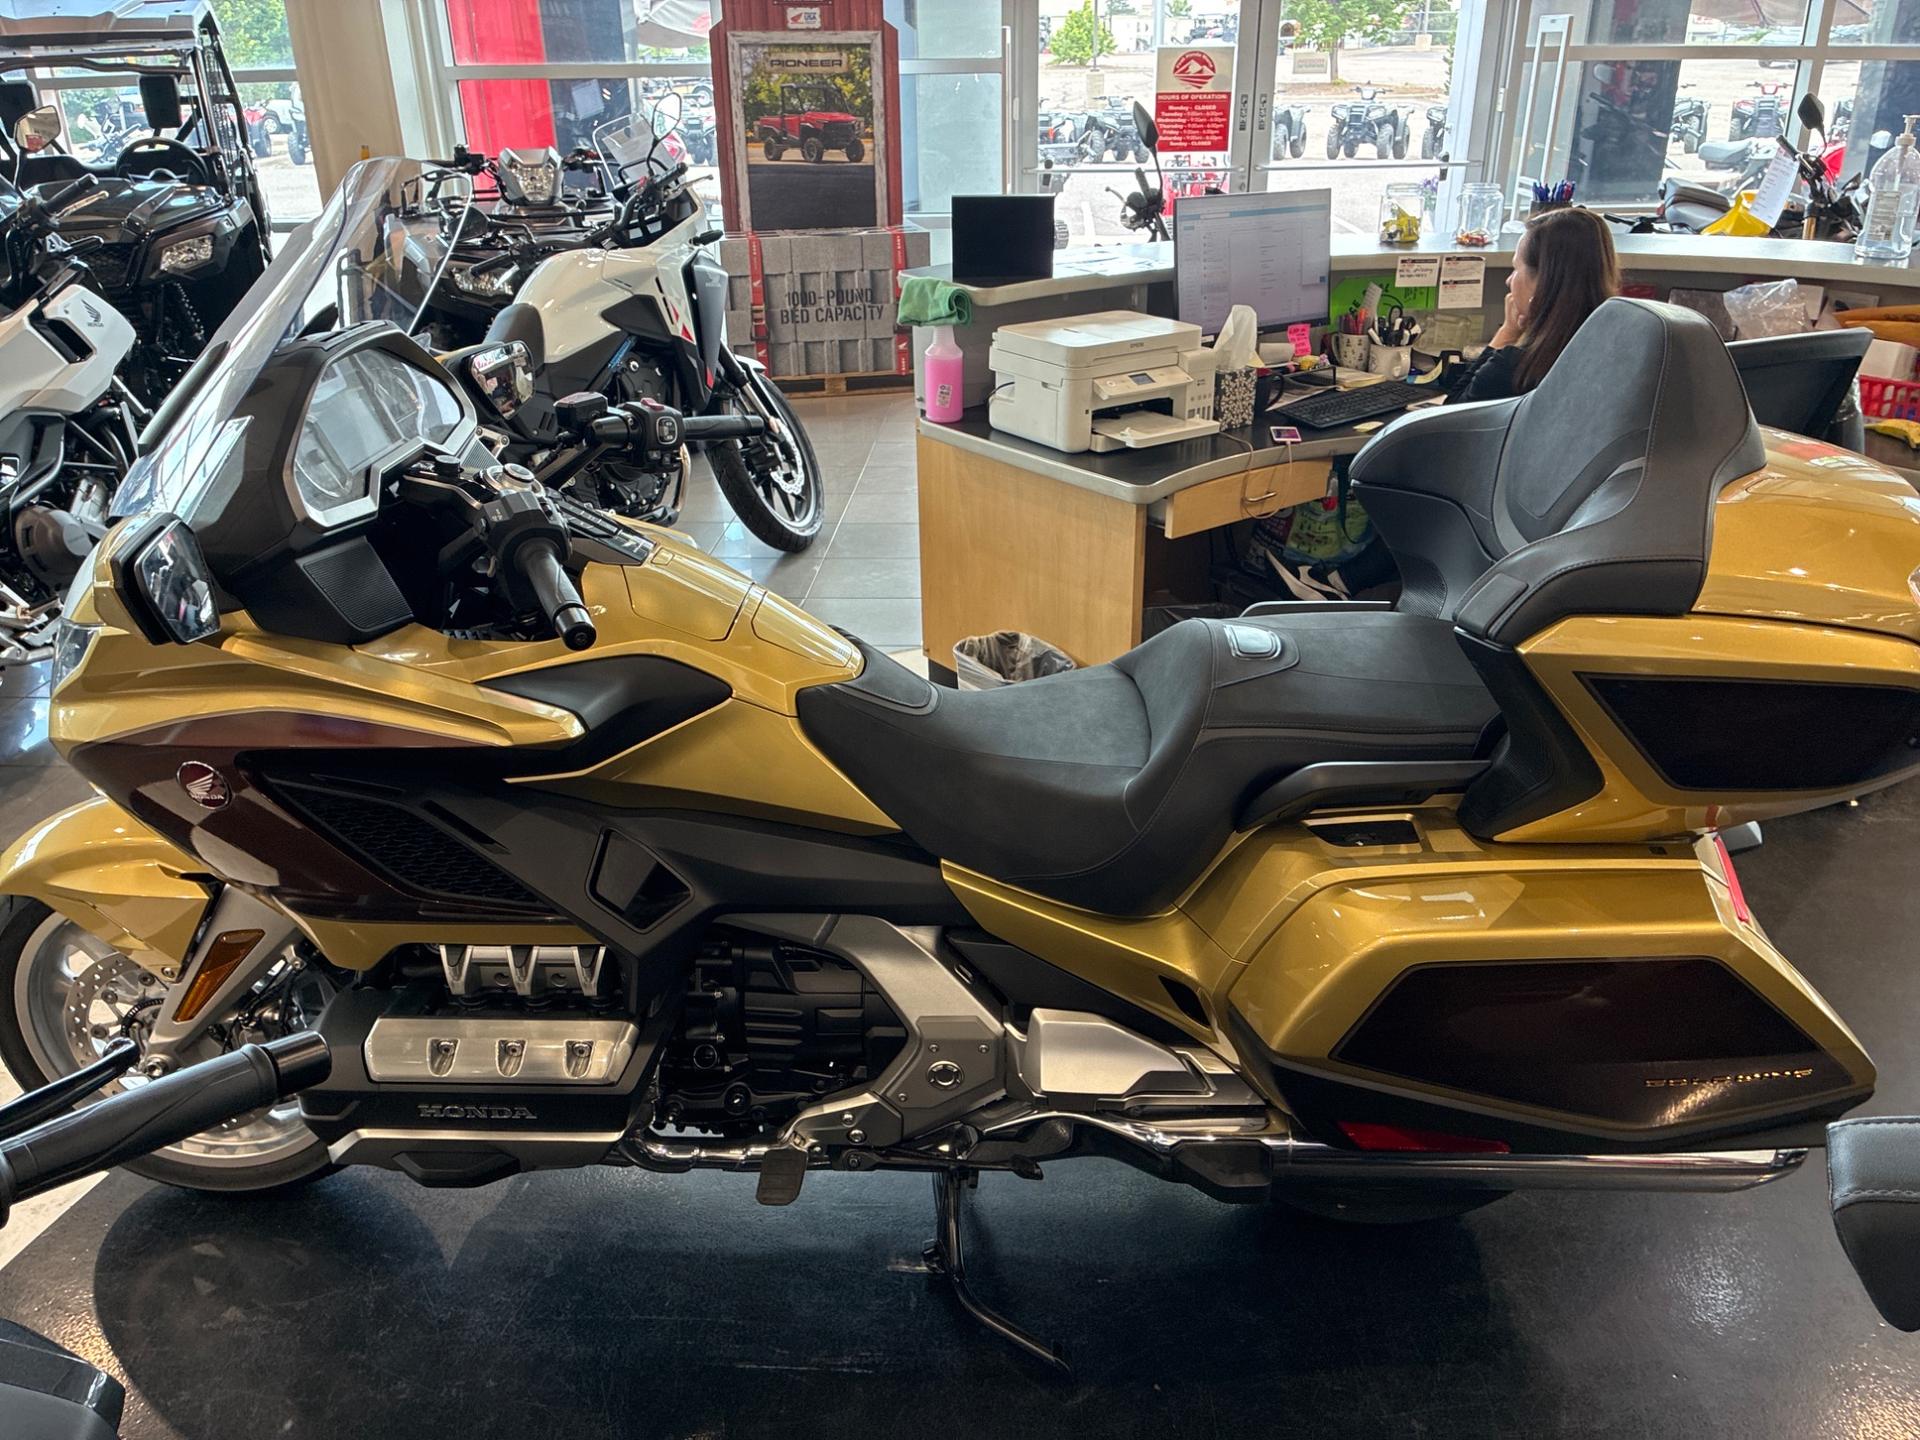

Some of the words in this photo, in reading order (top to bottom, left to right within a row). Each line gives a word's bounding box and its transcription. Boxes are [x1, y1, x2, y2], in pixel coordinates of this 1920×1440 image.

[770, 59, 842, 68] PIONEER
[786, 288, 873, 308] 1000-POUND
[780, 308, 810, 325] BED
[815, 305, 884, 323] CAPACITY
[417, 1105, 538, 1119] HONDA
